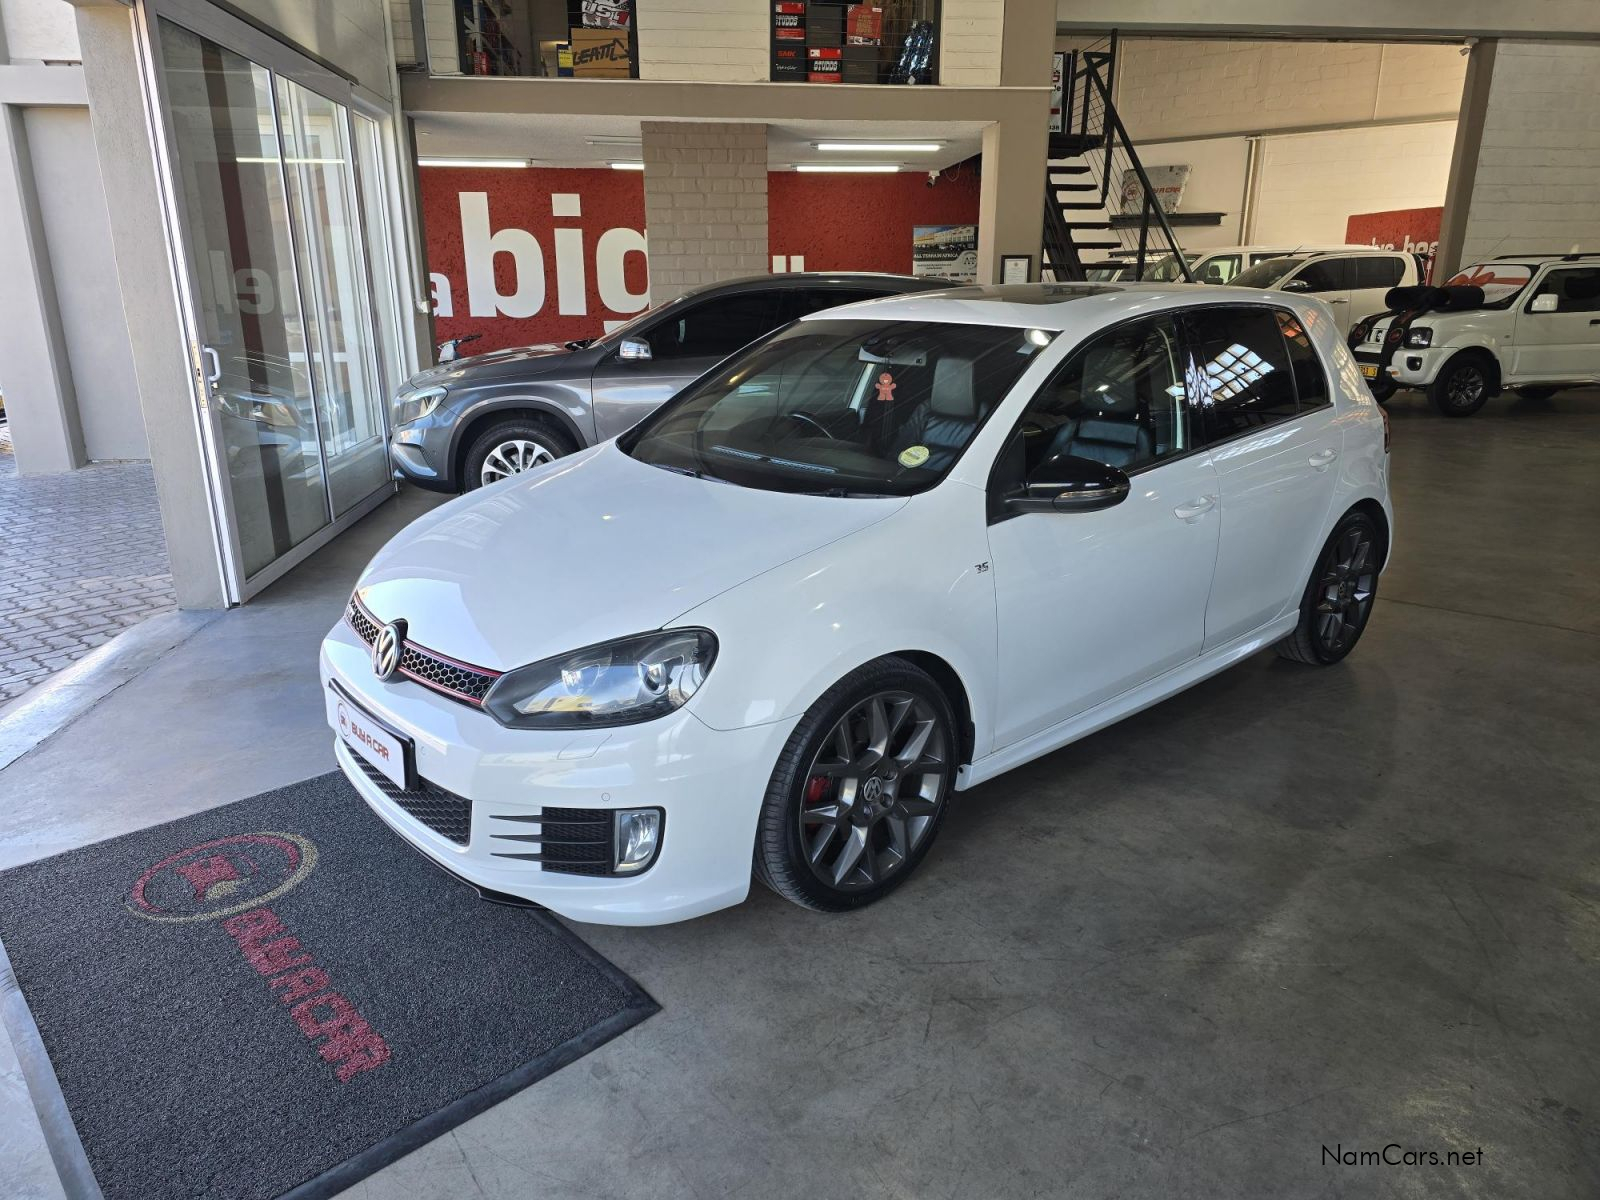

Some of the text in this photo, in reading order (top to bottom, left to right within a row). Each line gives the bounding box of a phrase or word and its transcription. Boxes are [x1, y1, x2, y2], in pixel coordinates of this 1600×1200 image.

[813, 60, 838, 71] STUDDS
[974, 561, 989, 574] 35
[351, 721, 390, 761] BUY A CAR
